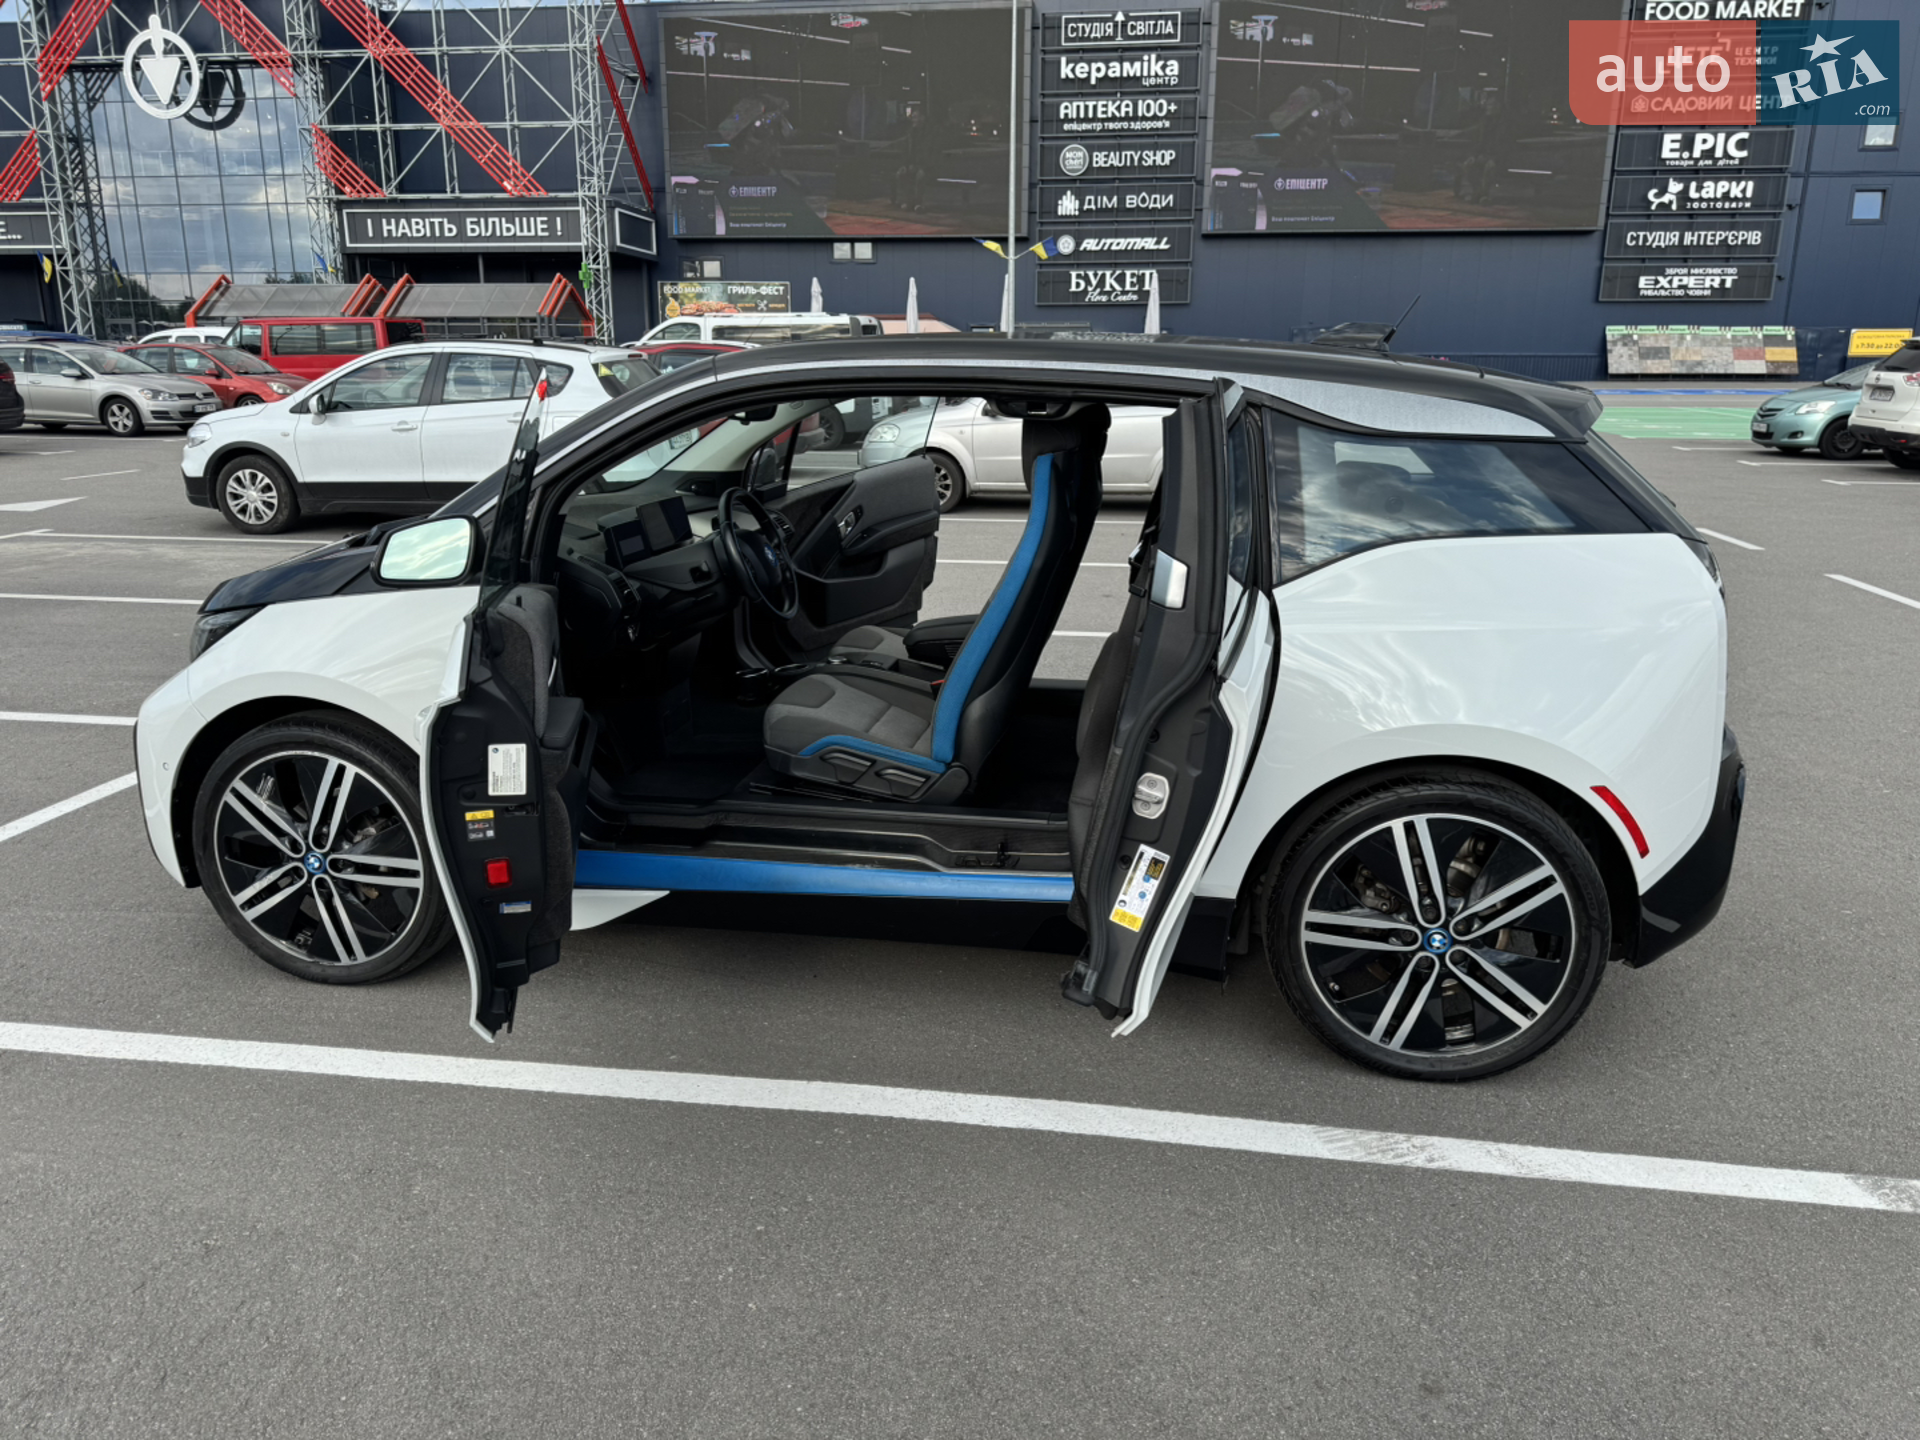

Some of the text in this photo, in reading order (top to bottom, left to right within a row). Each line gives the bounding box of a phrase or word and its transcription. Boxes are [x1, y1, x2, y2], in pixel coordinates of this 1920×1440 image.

[1645, 0, 1803, 20] FOOD MARKET
[1067, 20, 1175, 39] СТУДІЯ СВІТЛА
[1142, 76, 1179, 87] центр
[1059, 99, 1178, 120] АПТЕКА 100+
[1650, 95, 1734, 113] САДОВИЙ
[1661, 132, 1750, 159] E.PIC
[1093, 150, 1176, 167] BEAUTY SHOP
[1285, 178, 1328, 190] ЕПІЦЕНТР
[1083, 191, 1174, 211] ДІМ ВОДИ
[382, 217, 458, 238] НАВІТЬ
[466, 217, 549, 237] БІЛЬШЕ
[1080, 237, 1171, 251] AUTOMALL
[1626, 231, 1679, 248] СТУДІЯ
[1069, 270, 1157, 292] БУКЕТ
[1638, 276, 1738, 289] EXPERT
[727, 286, 785, 295] ГРИЛЬ-ФЕСТ
